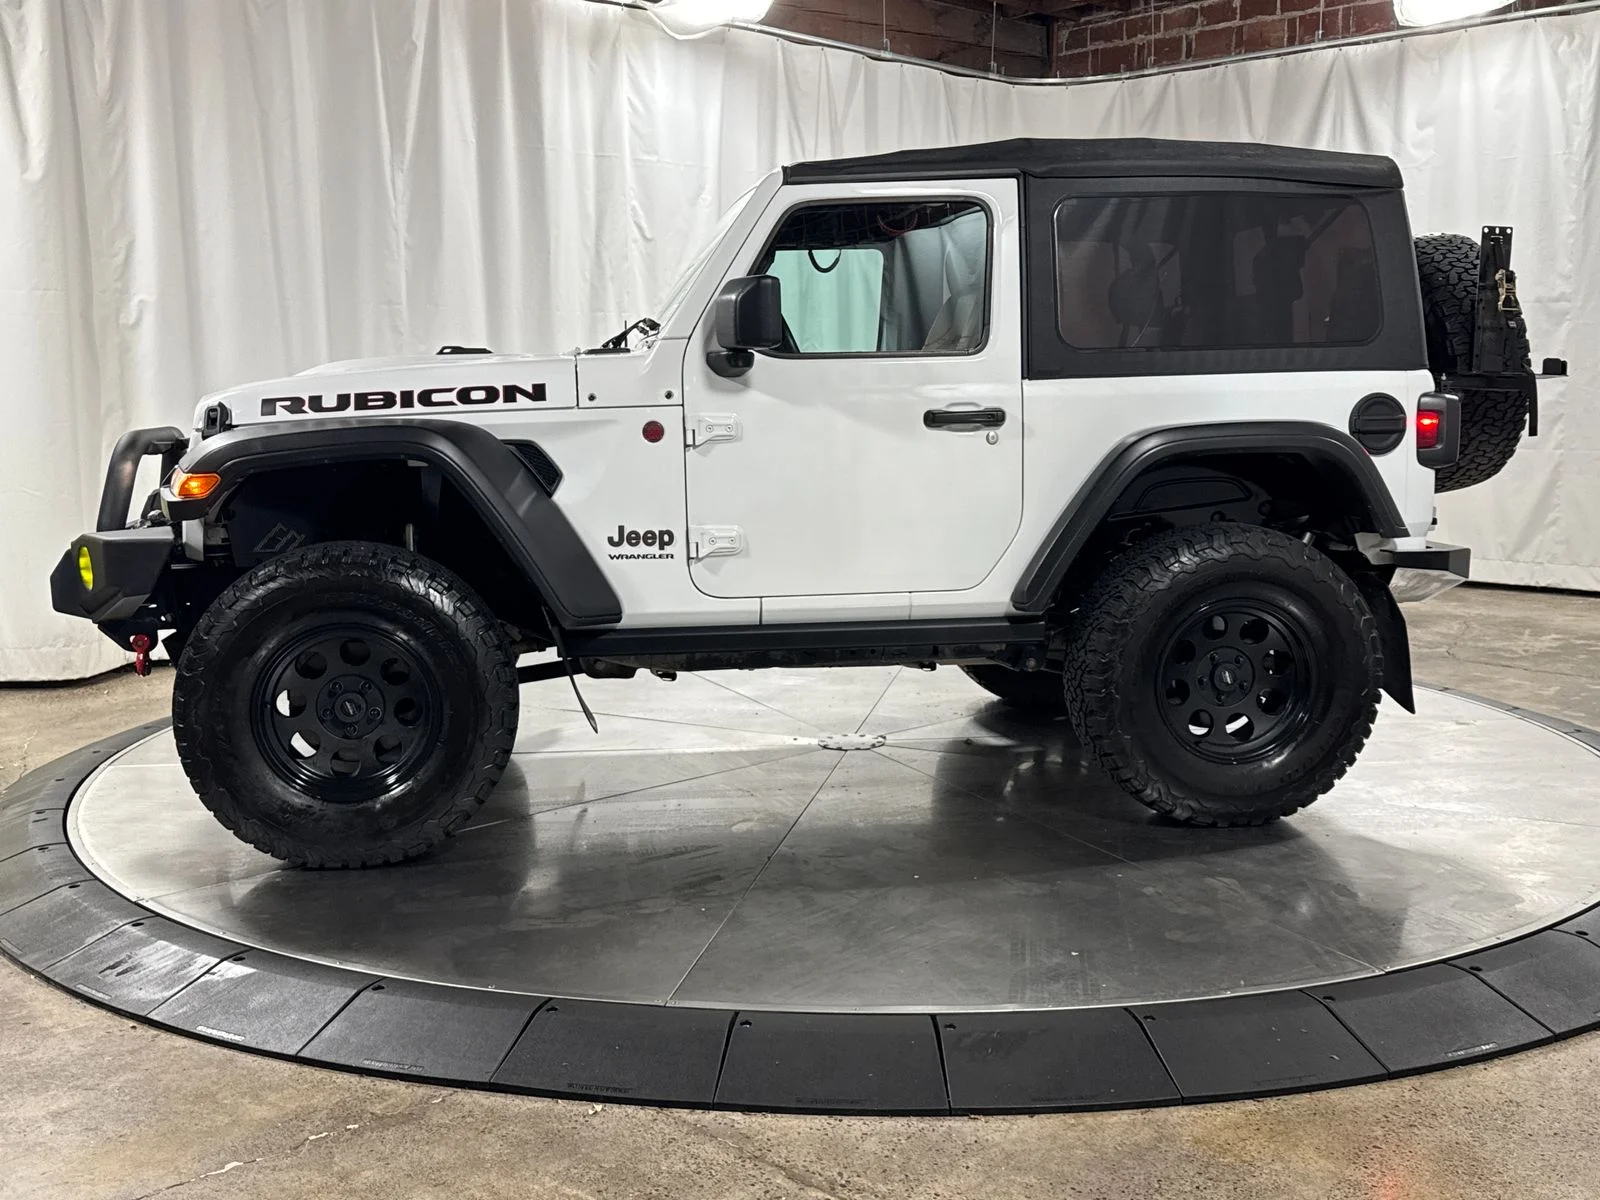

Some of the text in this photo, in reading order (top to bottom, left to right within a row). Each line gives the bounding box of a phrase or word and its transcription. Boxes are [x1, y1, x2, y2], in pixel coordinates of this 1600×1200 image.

[260, 382, 547, 416] RUBICON
[607, 525, 675, 551] Jeep
[607, 553, 675, 561] WRANGLER
